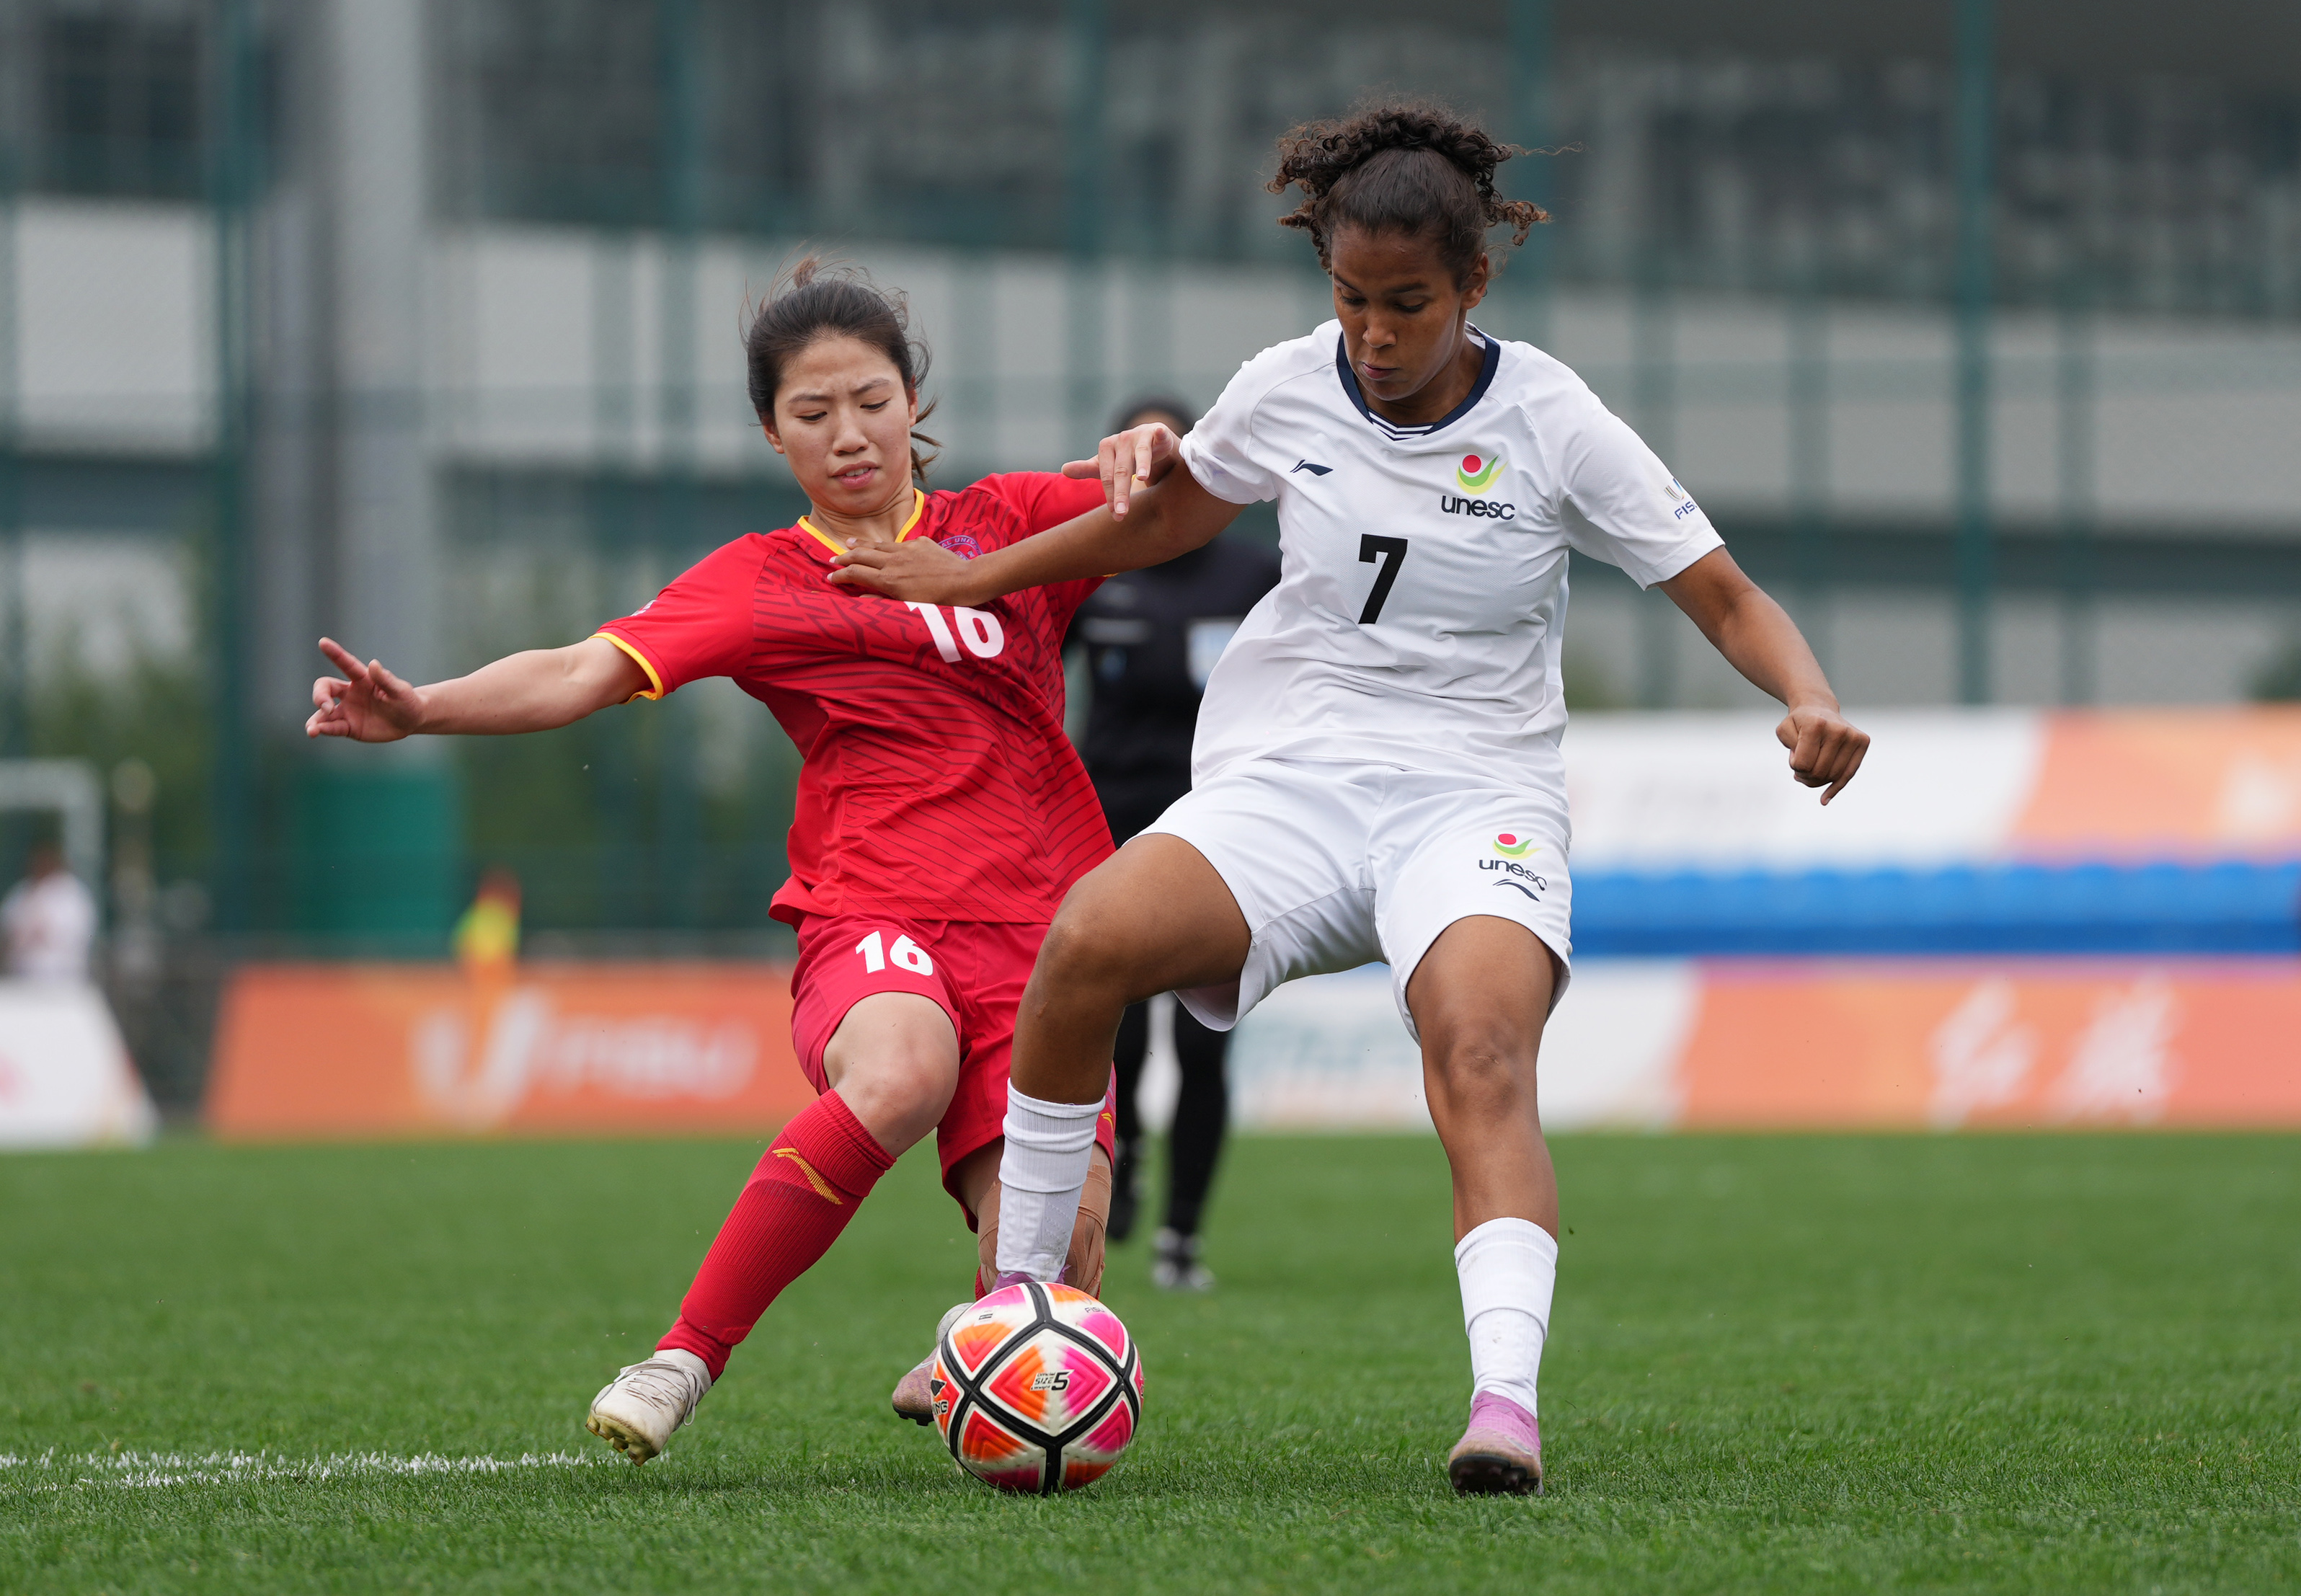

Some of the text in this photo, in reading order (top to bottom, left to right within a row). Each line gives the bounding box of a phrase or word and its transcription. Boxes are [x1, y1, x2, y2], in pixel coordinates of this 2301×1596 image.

[1441, 495, 1515, 520] unesc
[1674, 500, 1698, 520] FIS
[1358, 533, 1409, 625] 7
[903, 600, 1005, 664] 16
[1478, 859, 1548, 892] unesc
[855, 930, 934, 976] 16
[1034, 1371, 1070, 1391] SIZE 5
